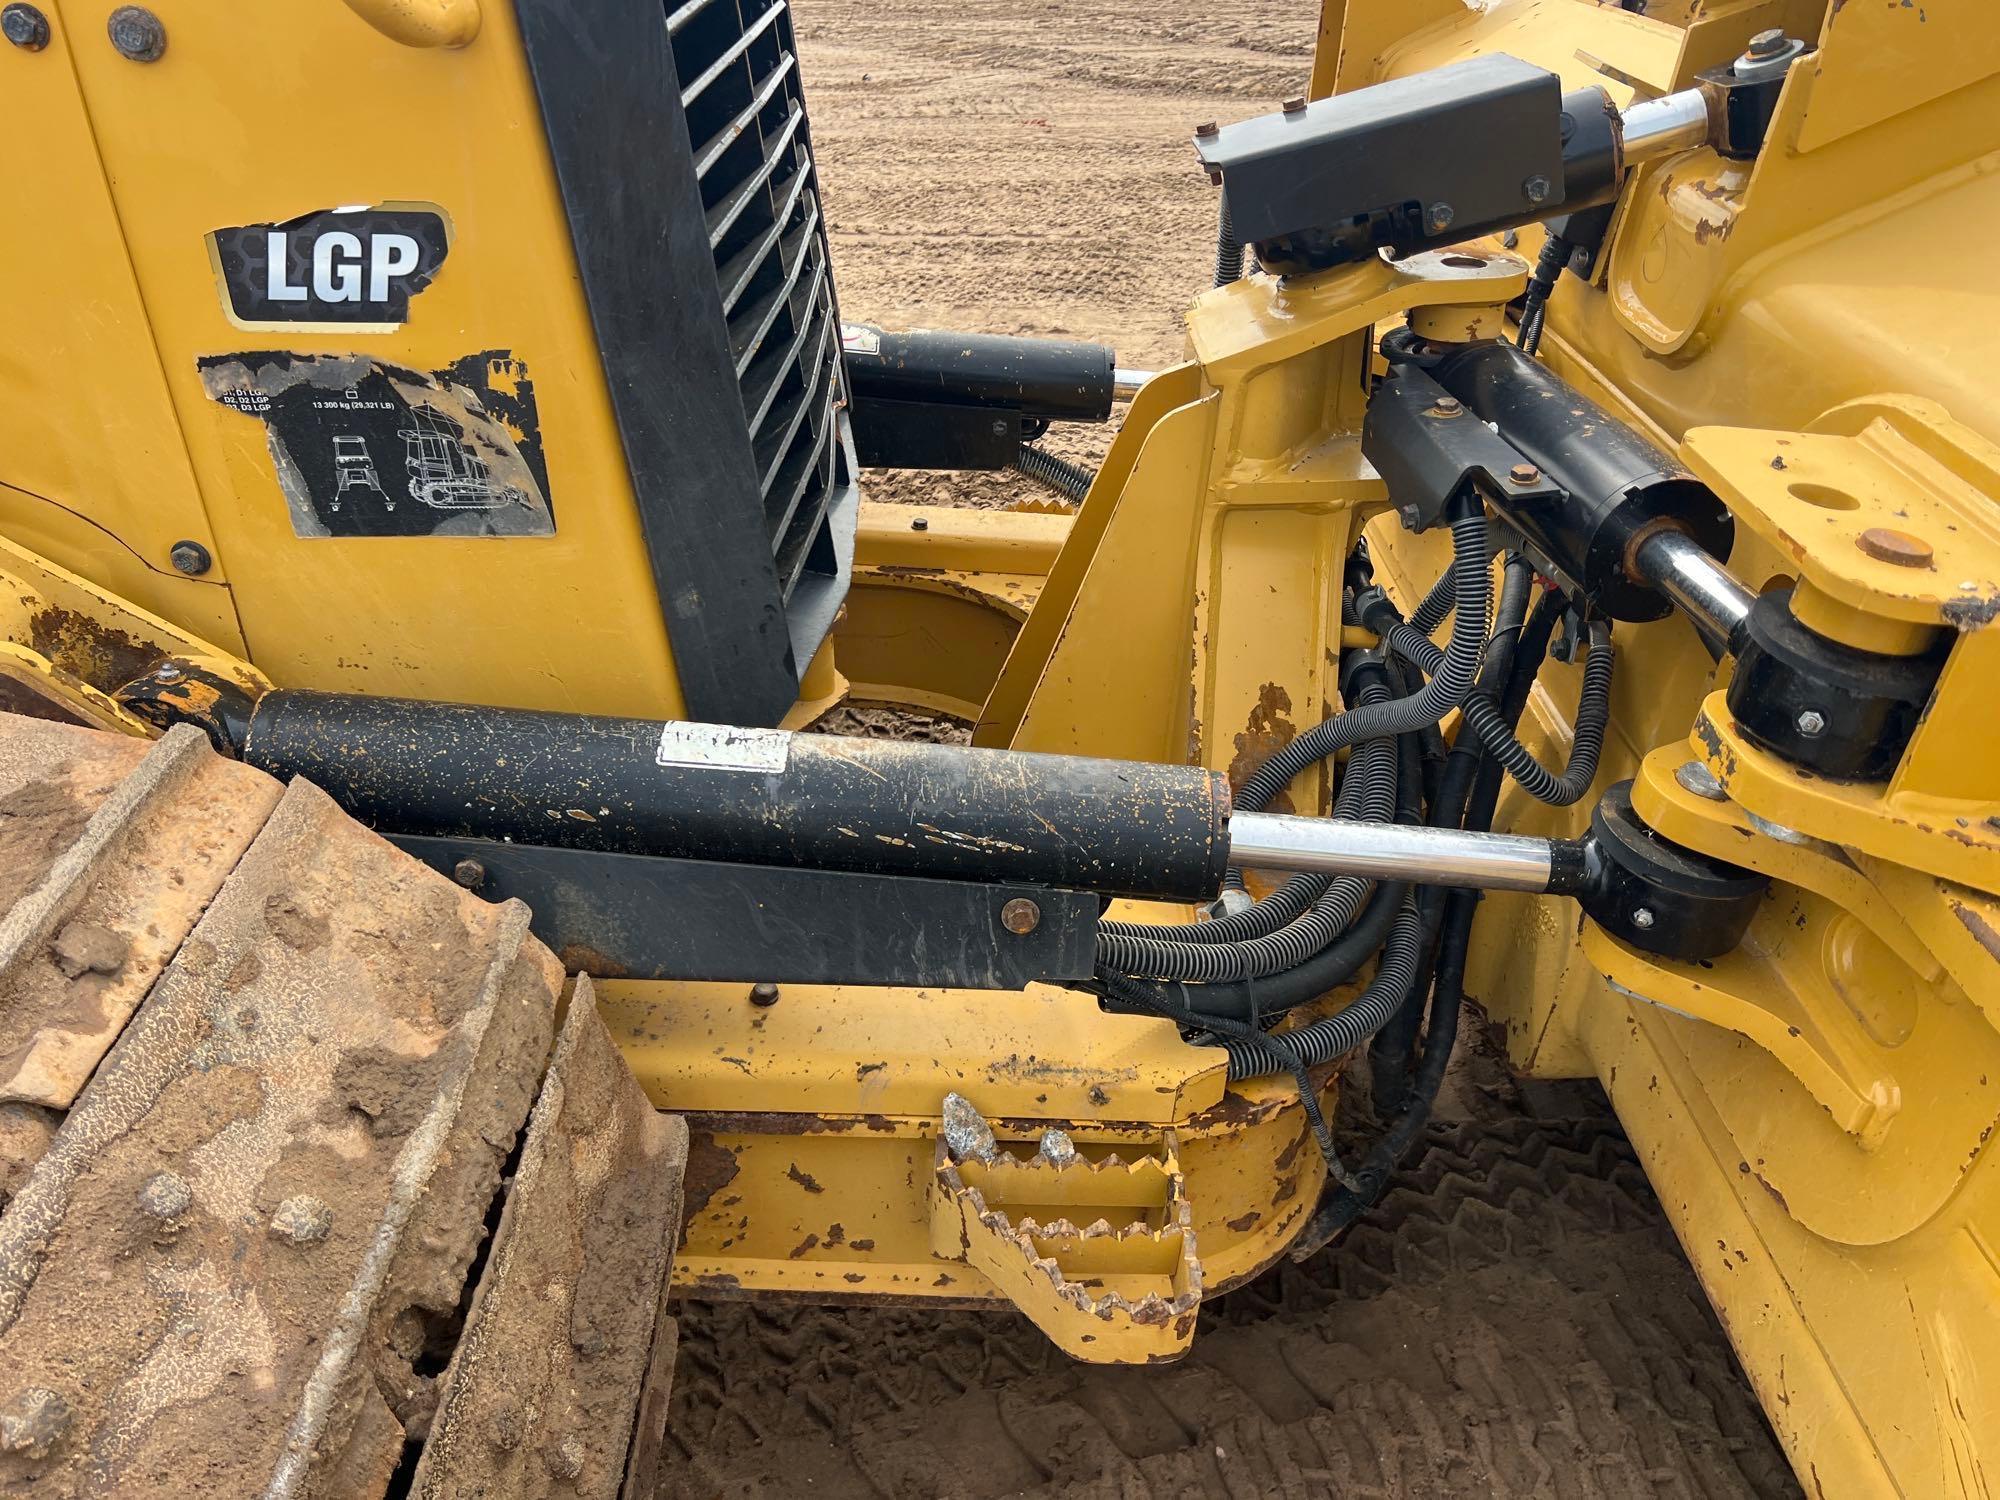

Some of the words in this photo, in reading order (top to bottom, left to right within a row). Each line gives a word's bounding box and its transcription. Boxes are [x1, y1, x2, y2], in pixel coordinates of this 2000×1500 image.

[267, 231, 419, 303] LGP
[224, 396, 238, 404] D2,
[239, 396, 250, 404] D2
[251, 396, 269, 404] LGP
[313, 401, 323, 409] 13
[324, 401, 339, 409] 300
[339, 401, 350, 410] kg
[380, 402, 395, 410] LB)
